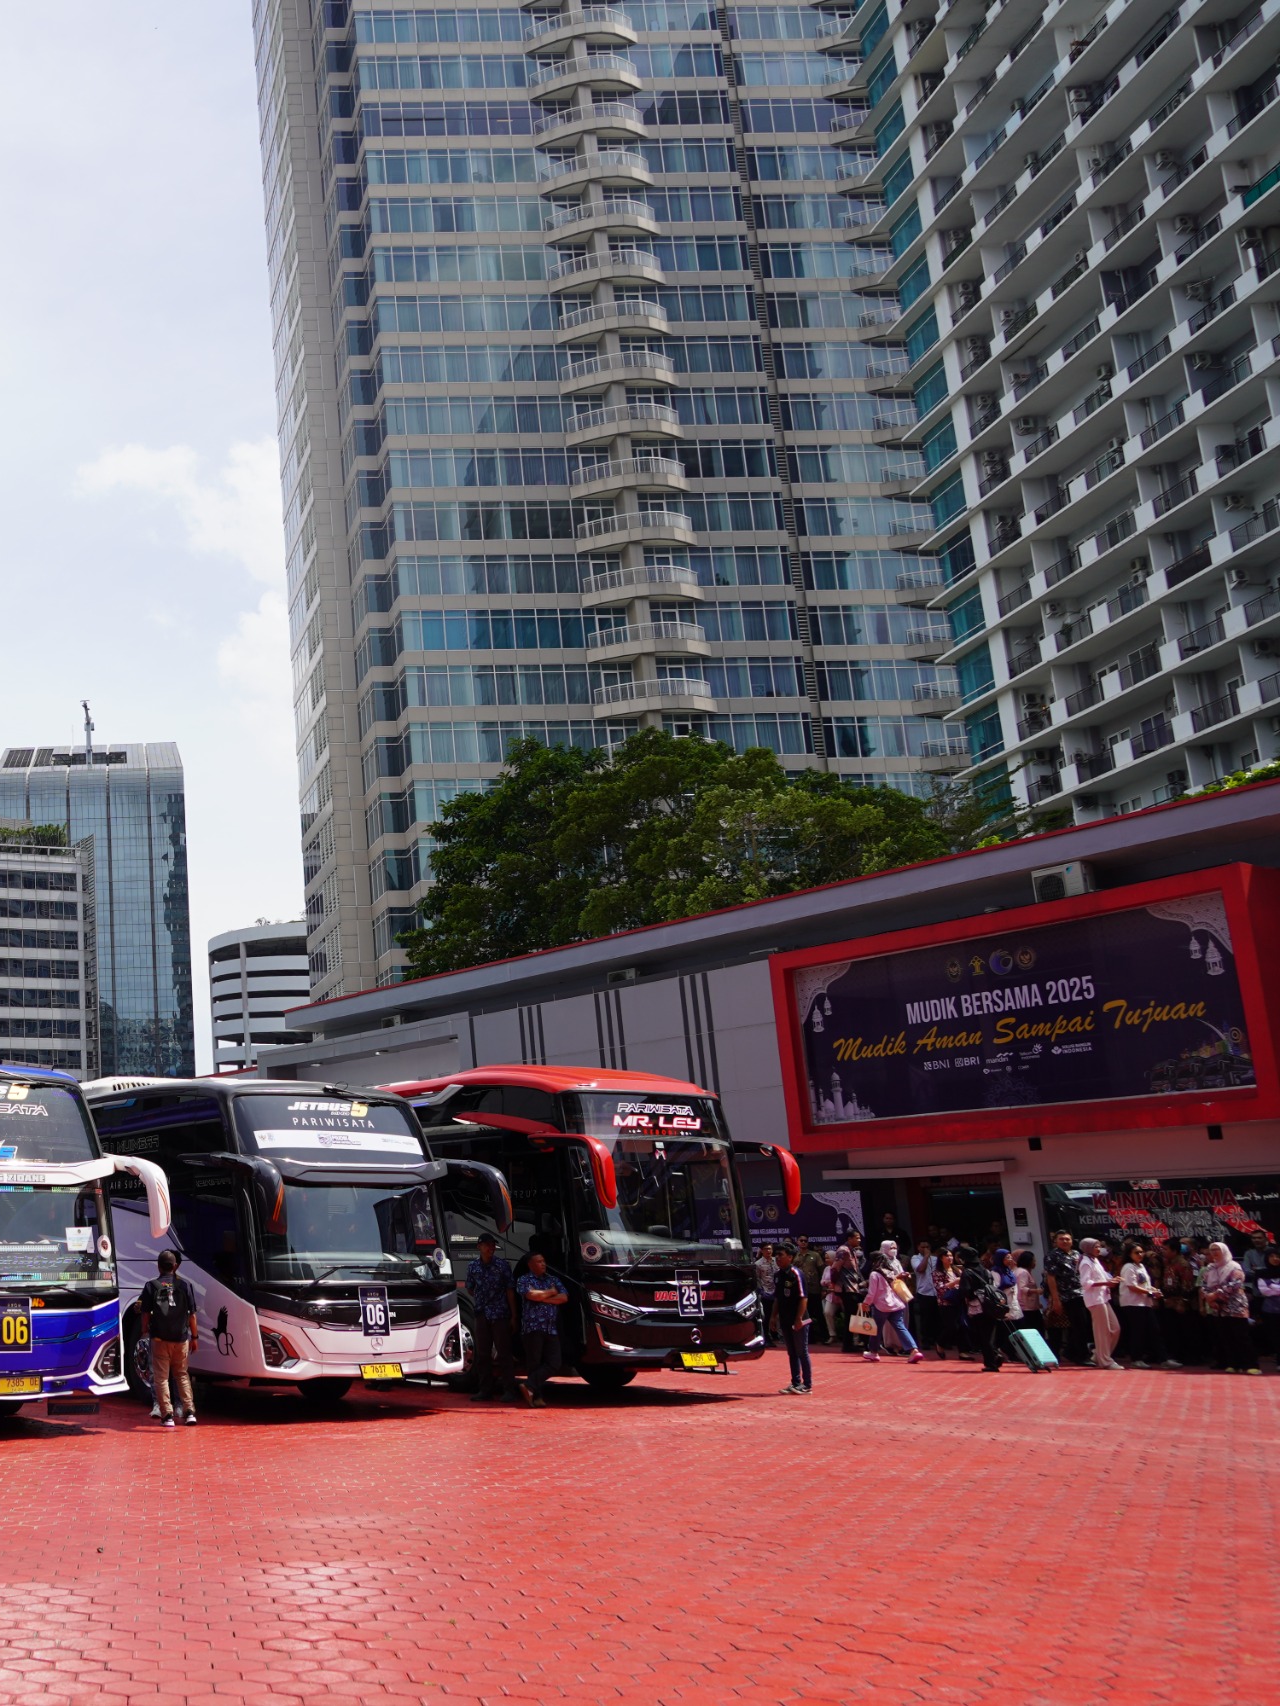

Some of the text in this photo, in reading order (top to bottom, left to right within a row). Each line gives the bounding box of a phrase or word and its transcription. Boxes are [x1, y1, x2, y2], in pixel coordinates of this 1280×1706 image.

[906, 975, 1095, 1025] MUDIK BERSAMA 2025
[832, 999, 1206, 1061] Mudik Aman Sampai Tujuan
[932, 1059, 950, 1070] BNI
[963, 1056, 980, 1066] BRI
[7, 1083, 29, 1100] 5
[287, 1101, 369, 1117] JETBUS 5
[617, 1102, 694, 1116] PARIWISATA
[292, 1117, 375, 1129] PARIWISATA
[612, 1114, 701, 1130] MR. LEY
[7, 1174, 46, 1183] ZIDANE
[1092, 1188, 1240, 1210] KLINIK UTAMA
[681, 1286, 698, 1305] 25
[366, 1303, 385, 1326] 06
[2, 1316, 28, 1345] 06
[6, 1377, 25, 1387] 7385
